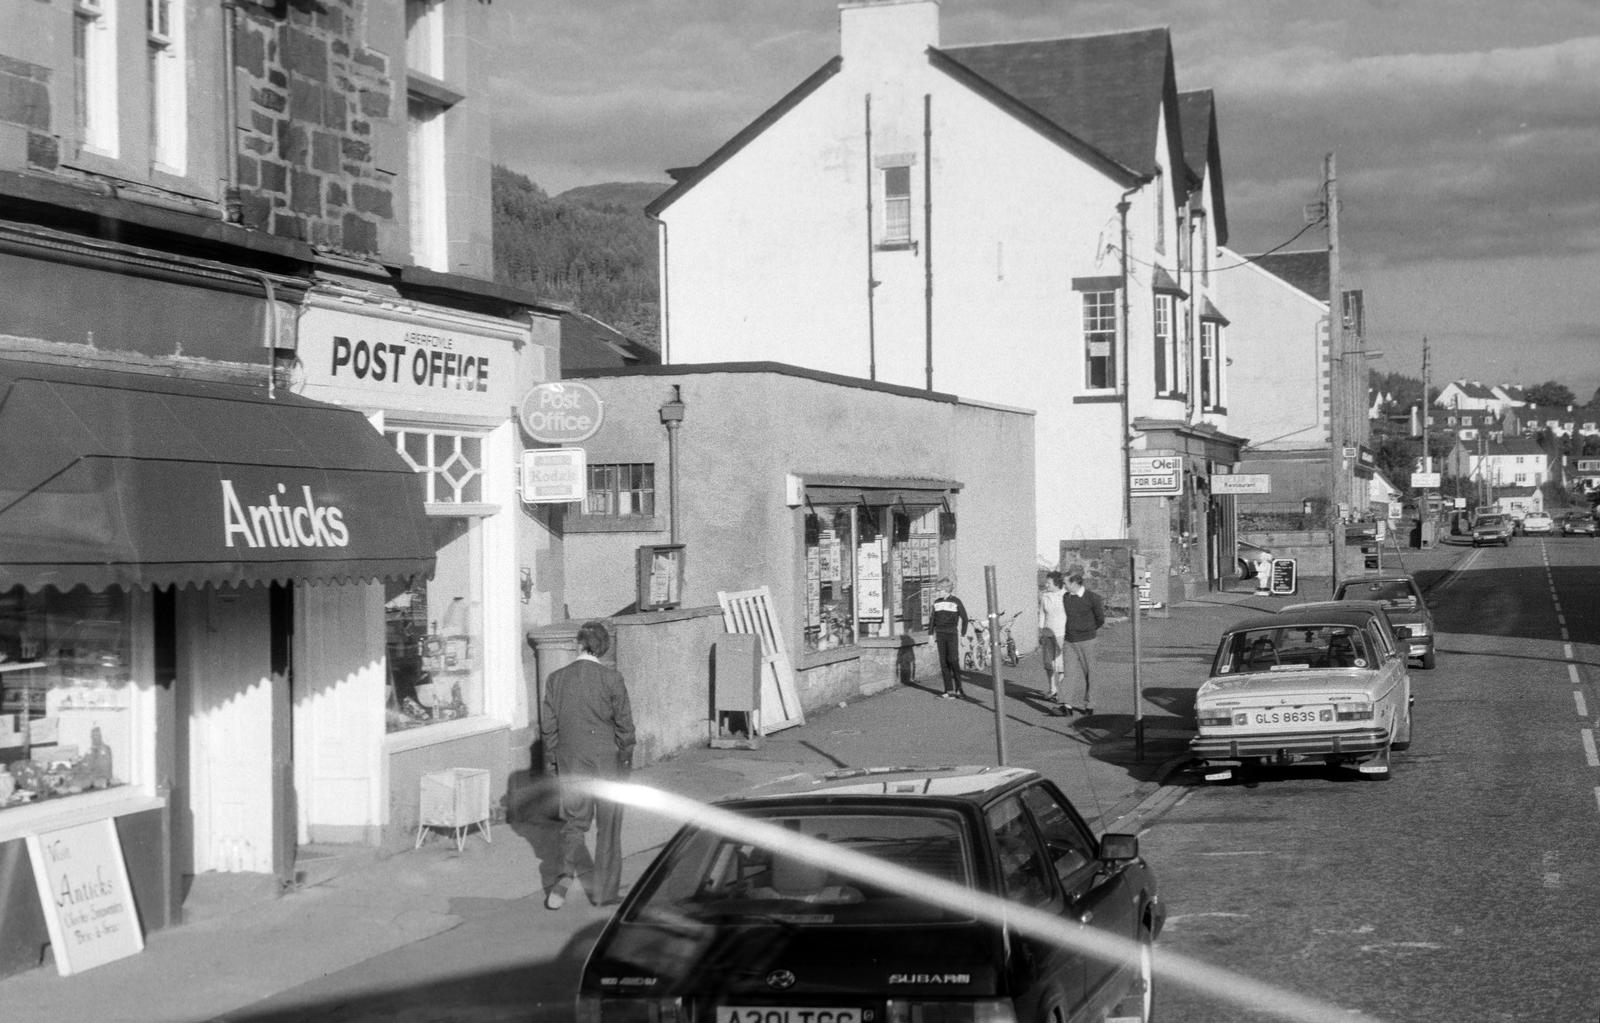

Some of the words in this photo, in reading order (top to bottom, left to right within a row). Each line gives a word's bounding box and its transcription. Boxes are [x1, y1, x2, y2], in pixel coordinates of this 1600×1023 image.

[331, 336, 406, 383] POST
[412, 348, 489, 393] OFFICE
[540, 390, 581, 409] Post
[529, 412, 592, 431] Office
[1134, 478, 1149, 486] FOR
[1151, 477, 1173, 486] SALE
[220, 479, 349, 548] Anticks
[1255, 713, 1280, 724] GLS
[1283, 711, 1316, 723] 863S
[889, 973, 970, 984] SUBARU
